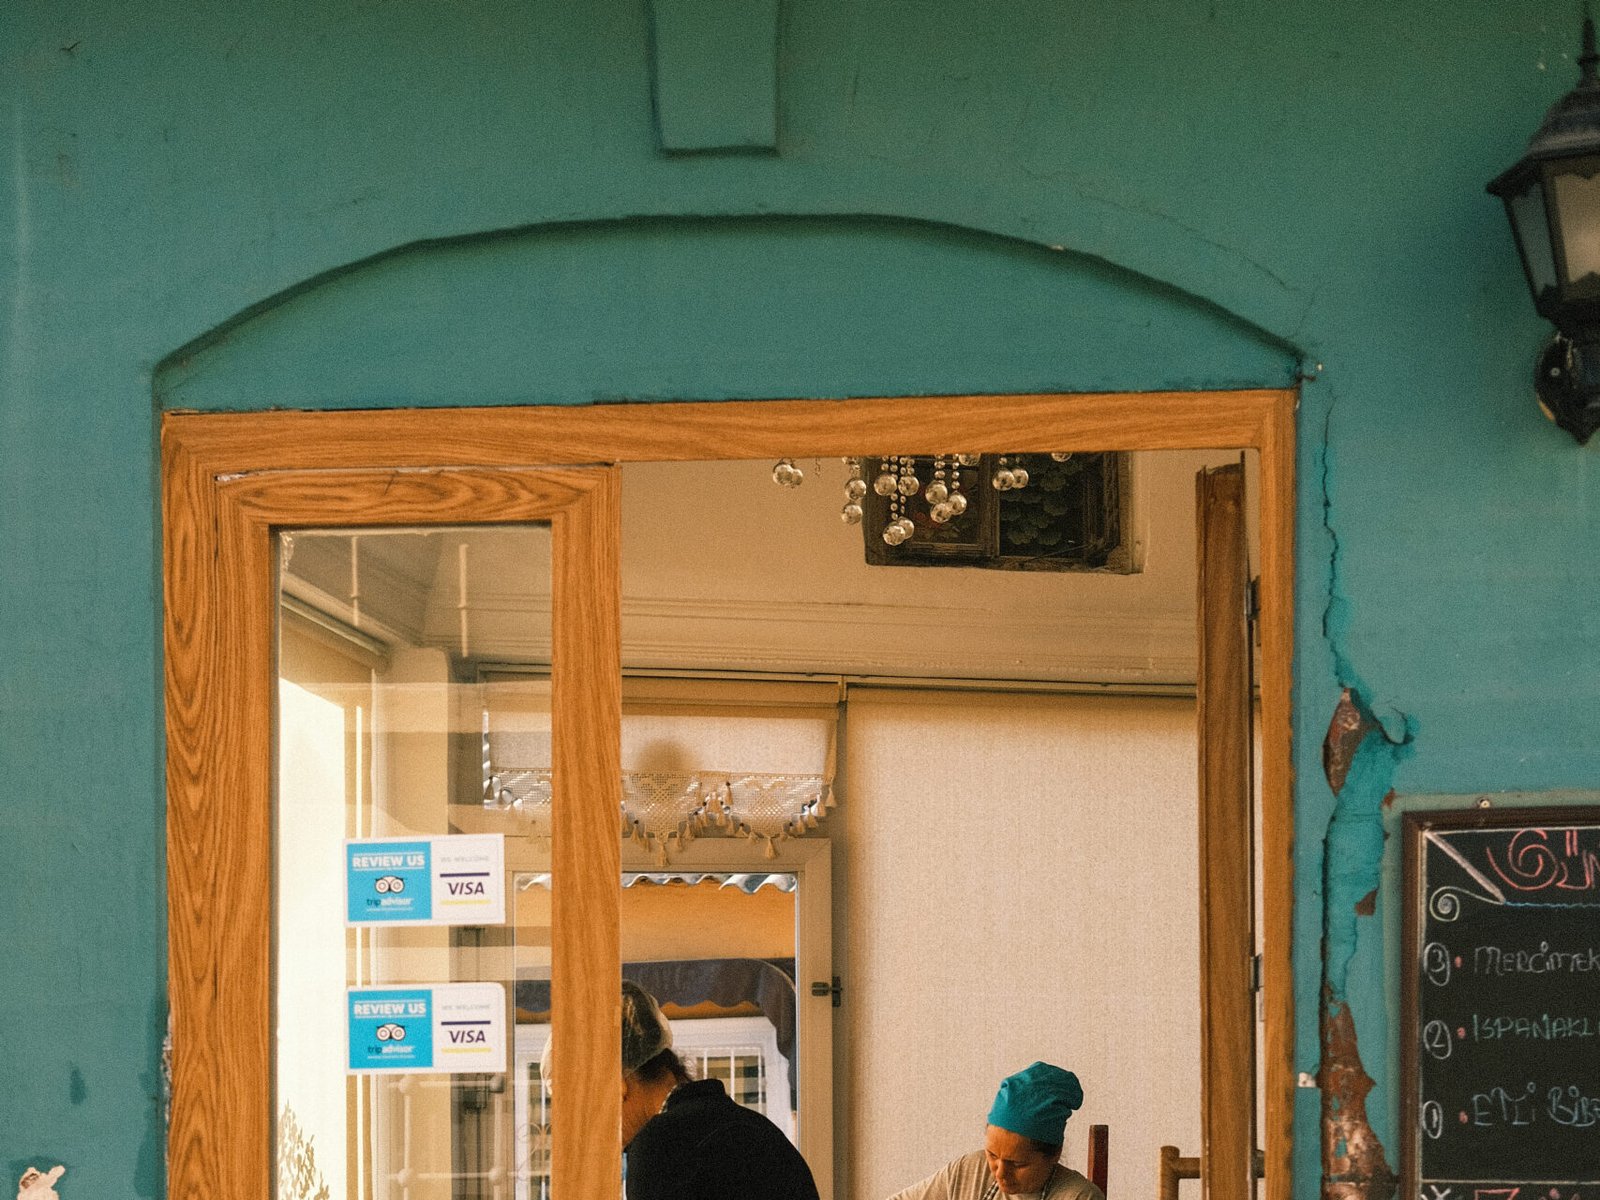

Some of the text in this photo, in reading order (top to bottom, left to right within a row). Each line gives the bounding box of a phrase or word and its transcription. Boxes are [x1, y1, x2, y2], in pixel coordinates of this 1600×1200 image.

[352, 854, 425, 868] REVIEW US
[448, 881, 485, 895] VISA
[354, 1002, 426, 1016] REVIEW US
[449, 1030, 486, 1044] VISA
